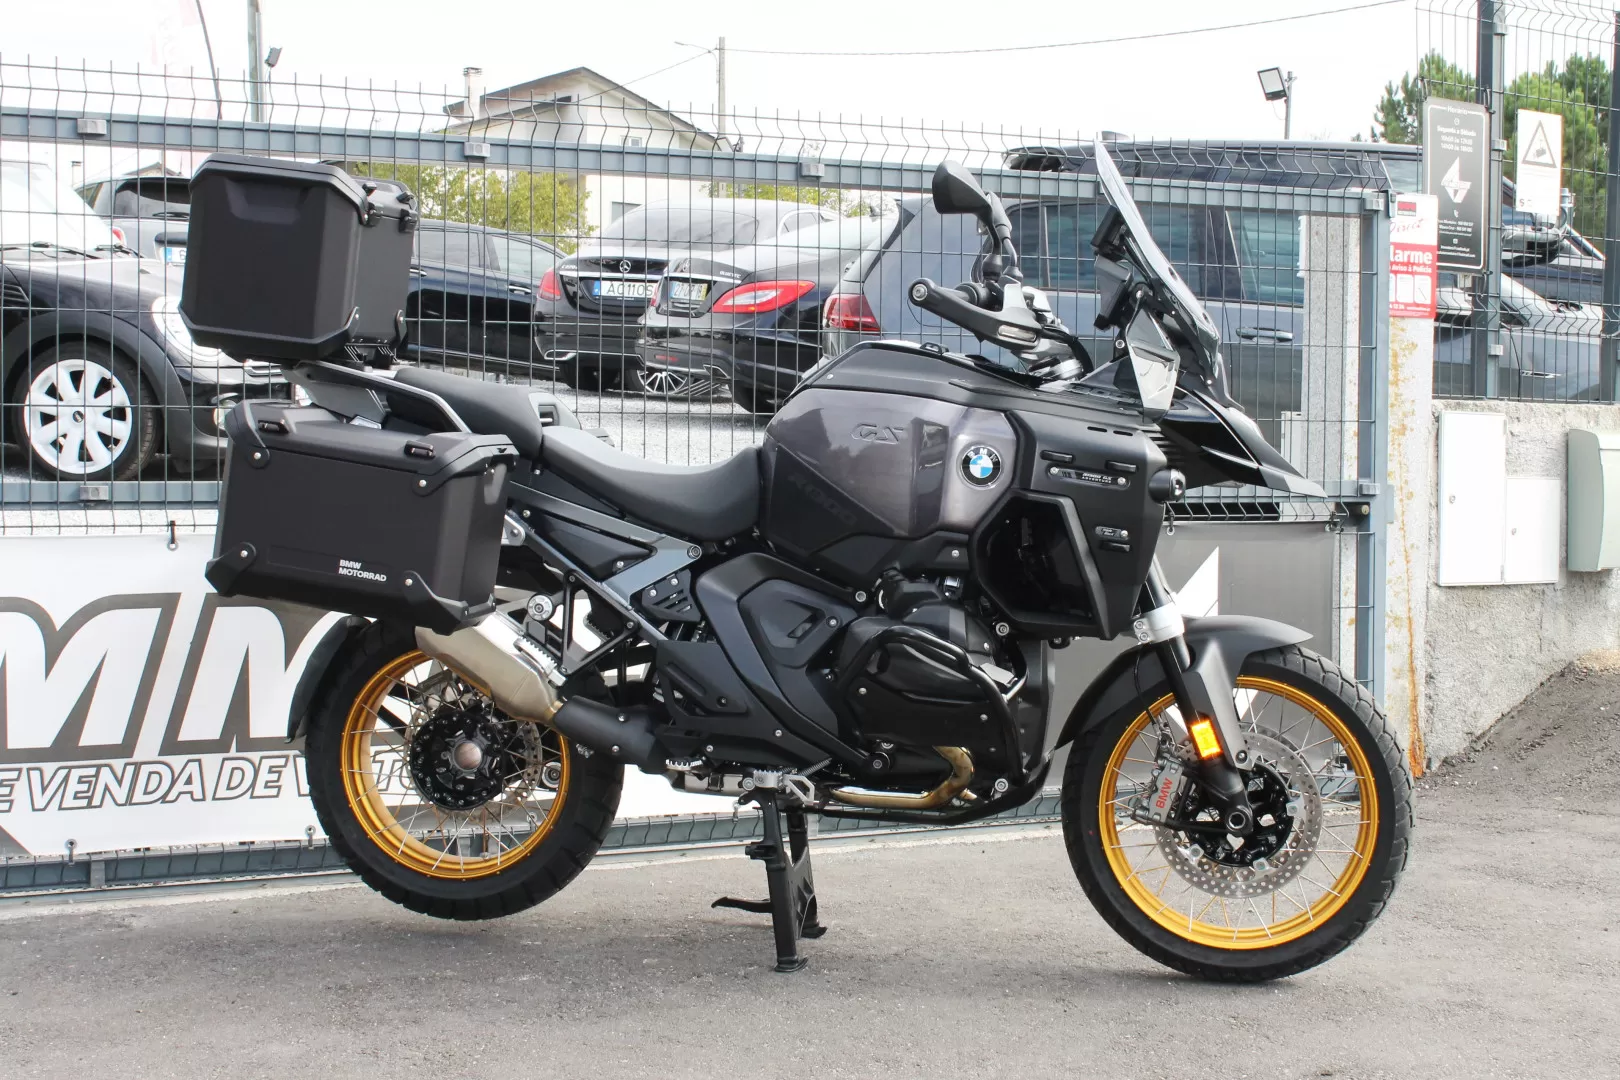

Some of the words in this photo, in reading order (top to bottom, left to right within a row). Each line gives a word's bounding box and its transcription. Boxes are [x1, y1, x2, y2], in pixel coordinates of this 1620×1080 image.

[338, 567, 387, 582] MOTORRAD
[339, 559, 362, 570] BMW
[26, 759, 206, 812] VENDA
[212, 754, 290, 801] DE
[1156, 777, 1174, 808] BMW
